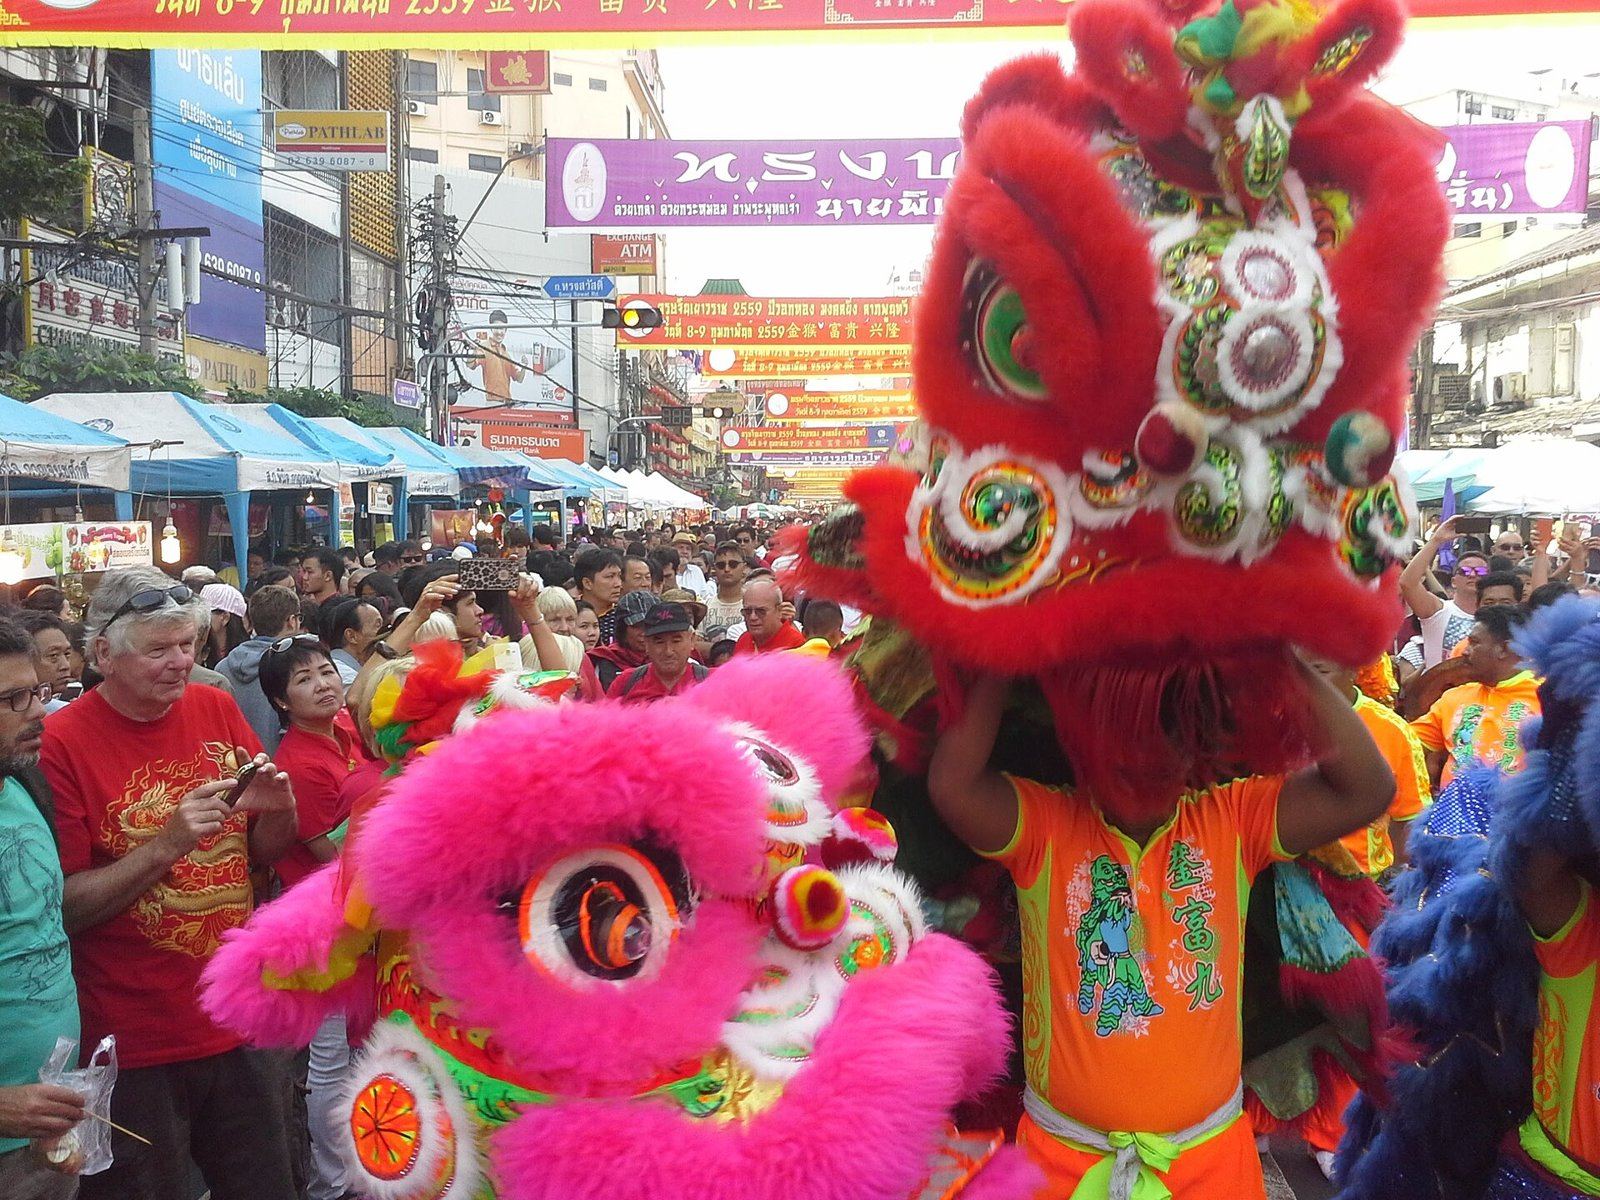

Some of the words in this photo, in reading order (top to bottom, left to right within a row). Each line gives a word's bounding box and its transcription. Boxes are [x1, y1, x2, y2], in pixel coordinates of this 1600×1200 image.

[309, 126, 385, 138] PATHLAB
[306, 156, 325, 165] 639
[330, 157, 356, 165] 6087
[620, 243, 652, 258] ATM
[732, 302, 762, 316] 2559
[686, 325, 706, 338] 8-9
[490, 434, 560, 448] ธนาคารธนชาต
